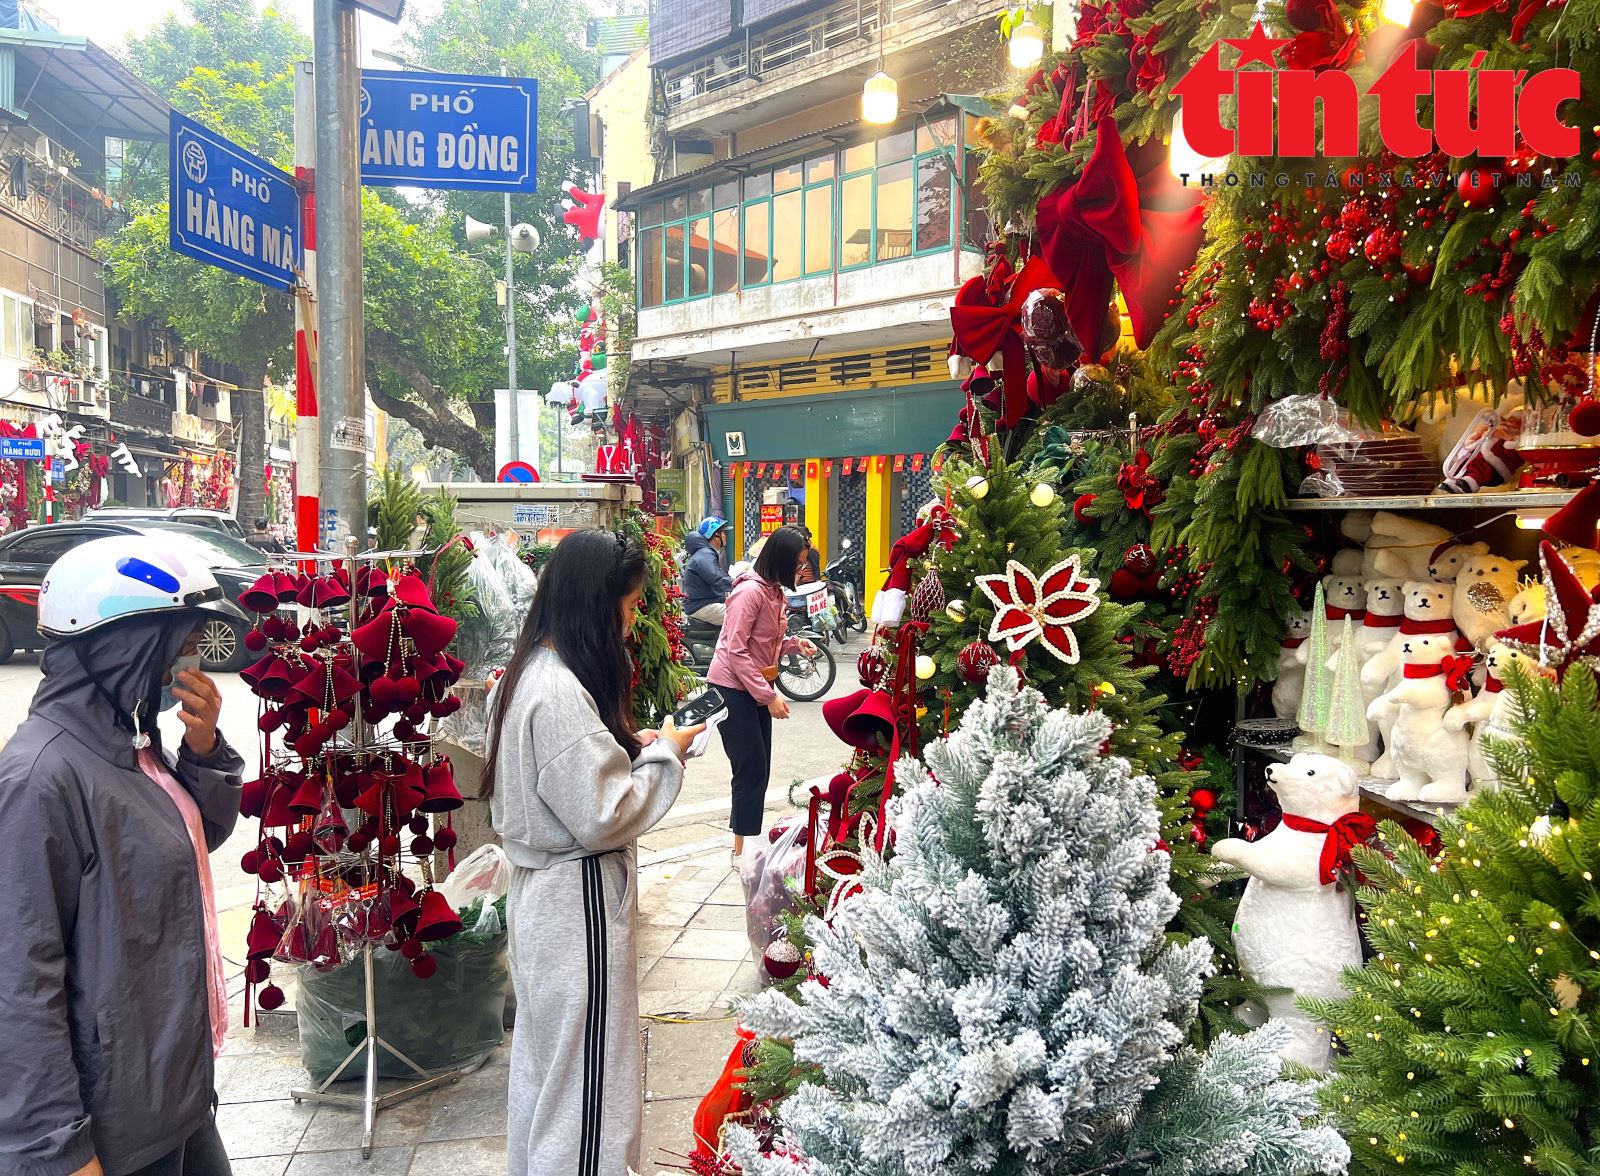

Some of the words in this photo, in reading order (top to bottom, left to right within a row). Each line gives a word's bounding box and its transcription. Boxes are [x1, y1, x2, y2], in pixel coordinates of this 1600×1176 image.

[410, 88, 477, 114] PHỐ
[361, 118, 425, 168] ÀNG
[436, 122, 519, 172] ĐỒNG
[231, 167, 273, 204] PHỐ
[186, 187, 255, 257] HÀNG
[262, 225, 295, 273] MÃ
[4, 447, 23, 455] HÀNG
[809, 603, 819, 614] ĐA
